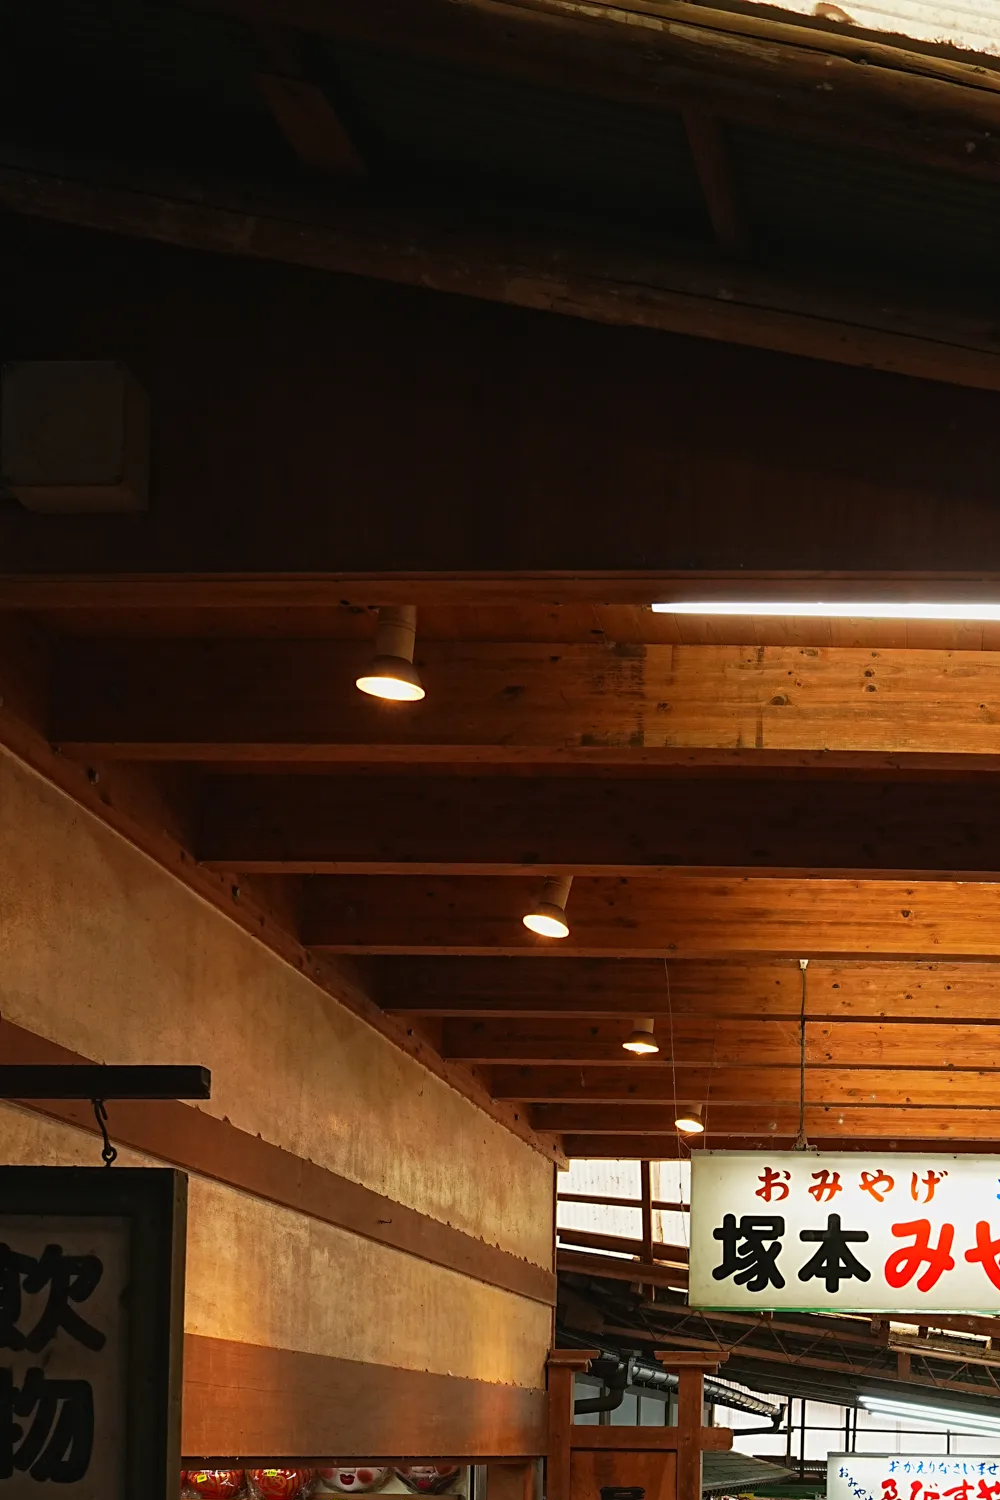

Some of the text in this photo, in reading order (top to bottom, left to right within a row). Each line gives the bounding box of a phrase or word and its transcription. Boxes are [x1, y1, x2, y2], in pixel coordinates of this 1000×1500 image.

[755, 1166, 948, 1203] おみやげ
[888, 1460, 1000, 1476] おかえりなさいませ
